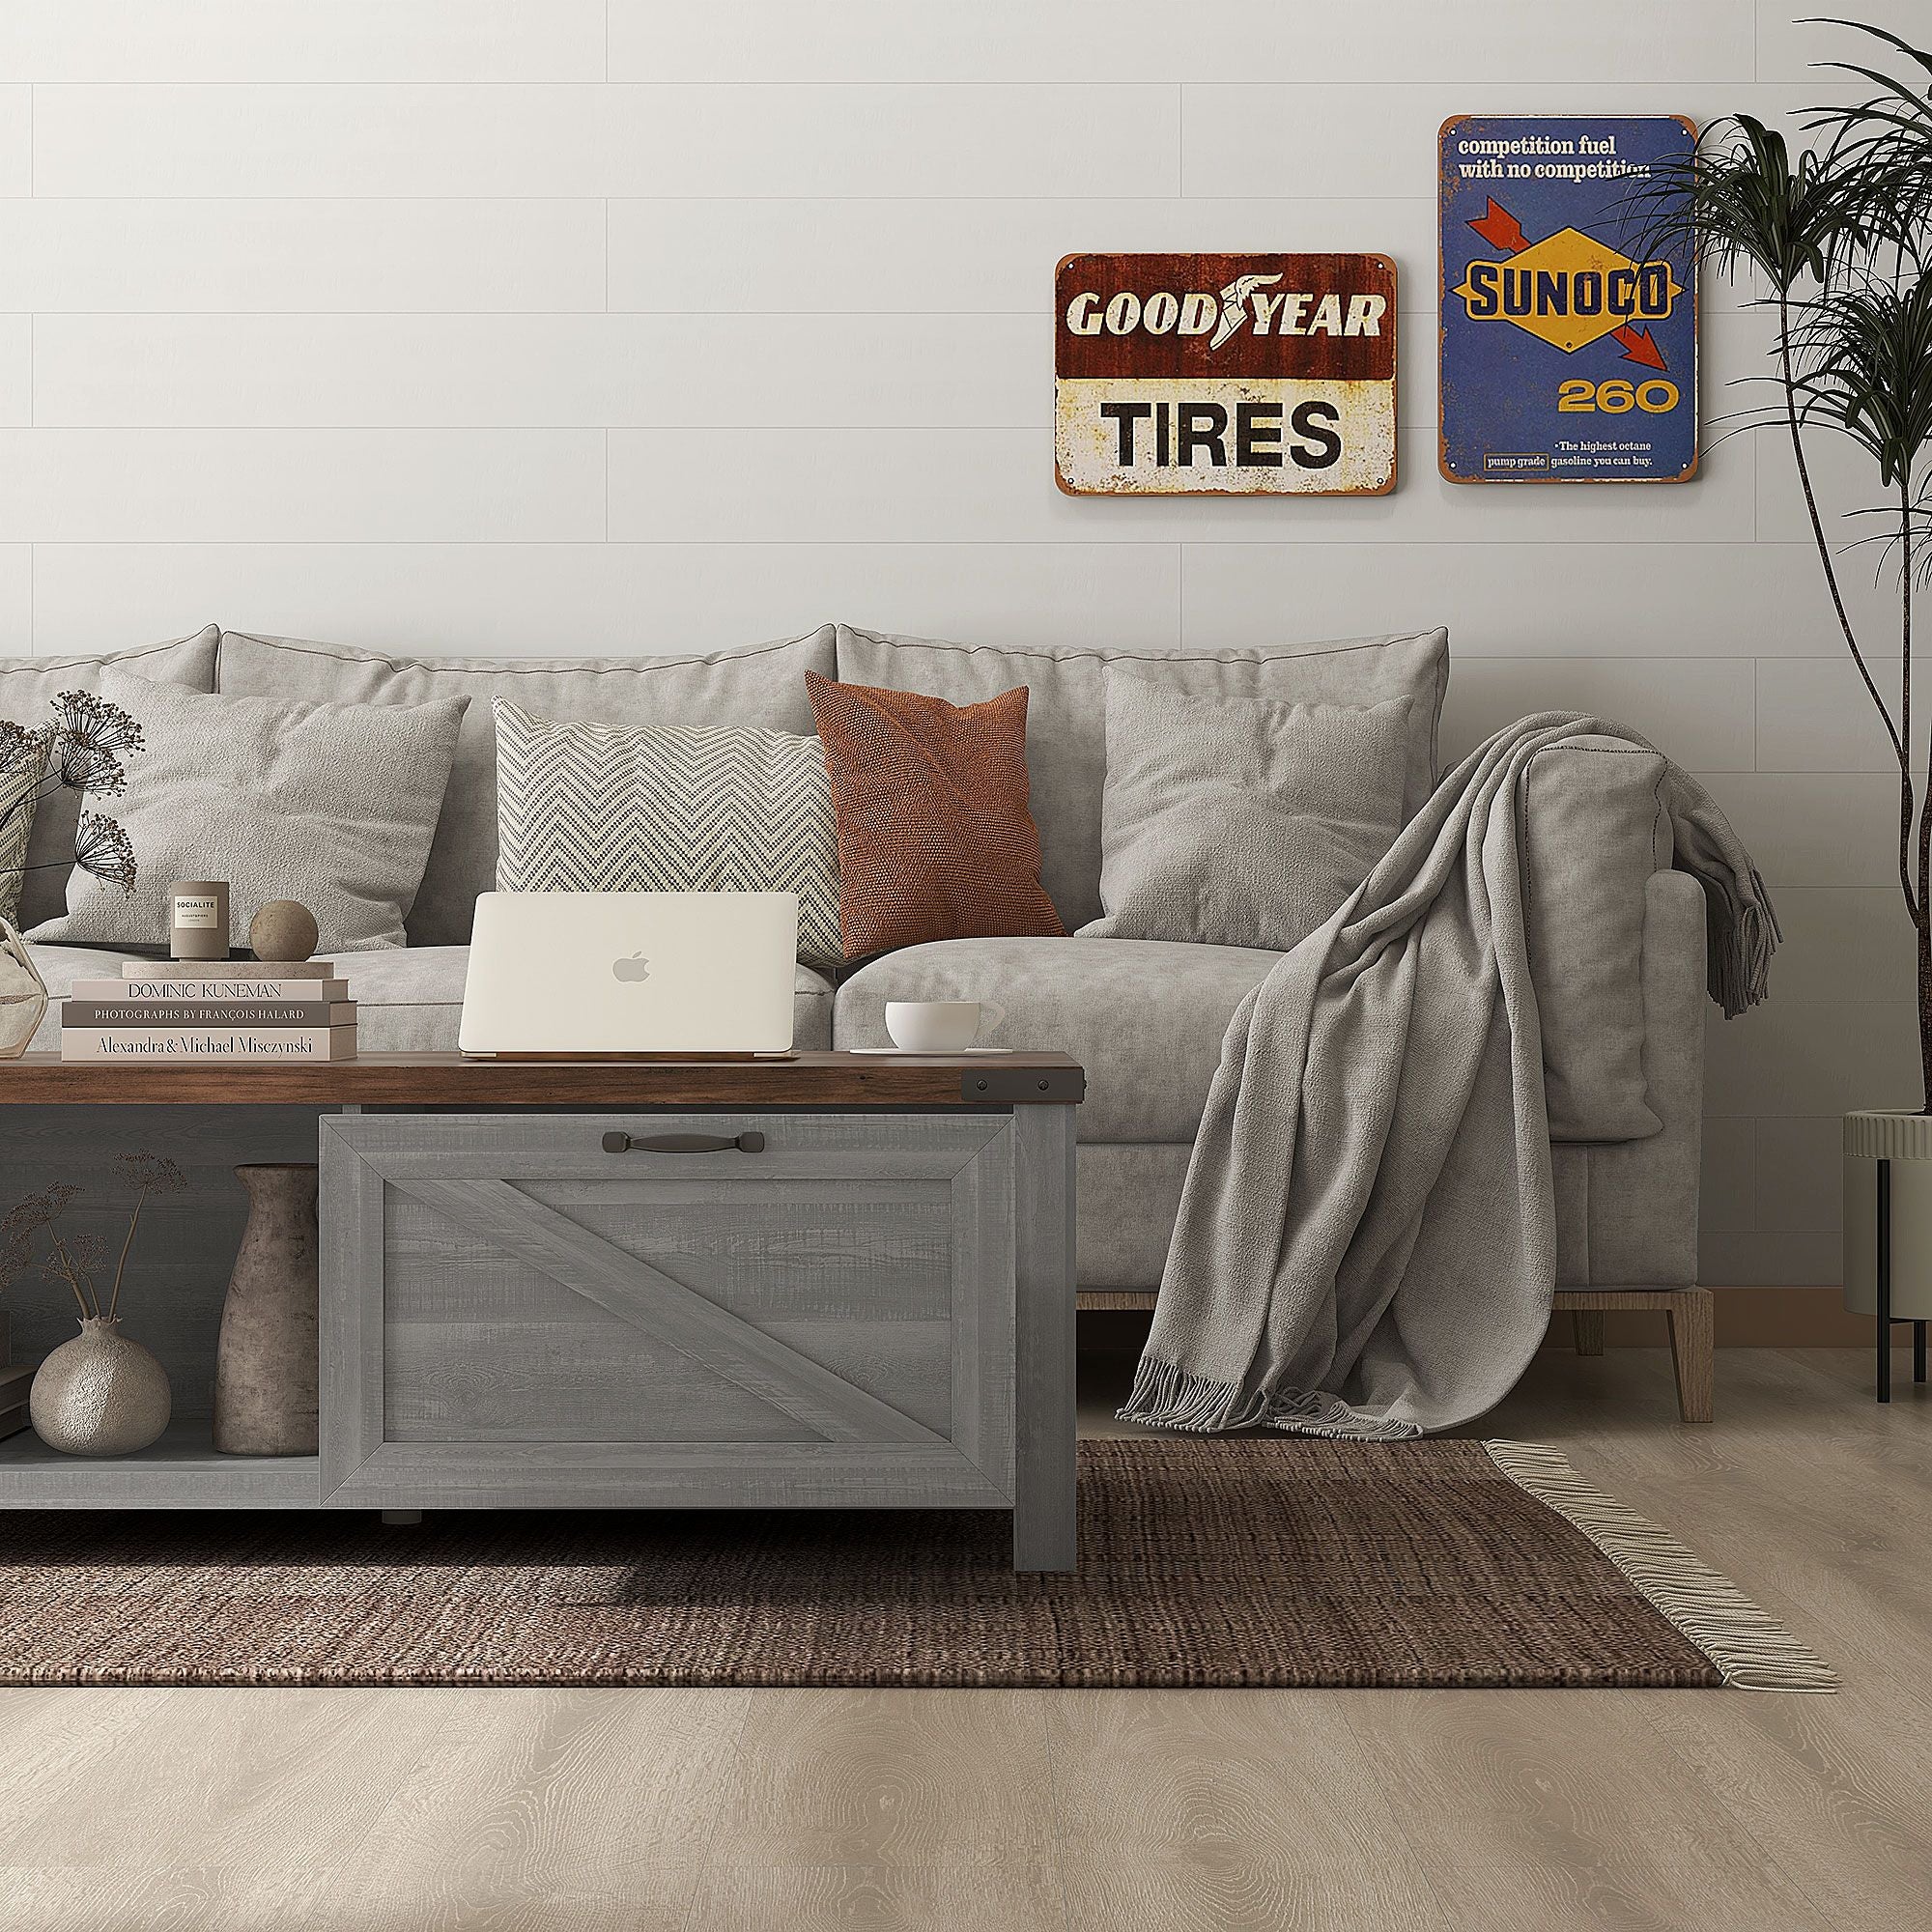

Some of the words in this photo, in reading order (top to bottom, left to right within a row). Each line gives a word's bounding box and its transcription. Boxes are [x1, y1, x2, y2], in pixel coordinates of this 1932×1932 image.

[1458, 135, 1575, 159] competition
[1578, 135, 1617, 155] fuel
[1459, 159, 1504, 179] with
[1507, 163, 1531, 179] no
[1470, 265, 1668, 316] SUNOCO
[1557, 379, 1680, 414] 260
[1100, 401, 1342, 469] TIRES
[1579, 441, 1617, 454] highest
[1618, 442, 1652, 451] octane
[1488, 458, 1517, 469] pump
[1517, 456, 1546, 469] grade
[1550, 456, 1592, 468] gasoline
[1593, 458, 1611, 468] you
[1633, 456, 1653, 468] buy.
[128, 983, 196, 998] DOMINIC
[202, 983, 282, 998] KUNEMAN
[94, 1009, 180, 1020] PHOTOGRAPHS
[183, 1009, 196, 1020] BY
[199, 1009, 255, 1022] FRANÇOIS
[258, 1009, 304, 1020] HALARD
[181, 1037, 234, 1054] Michael
[238, 1037, 313, 1059] Misczynski
